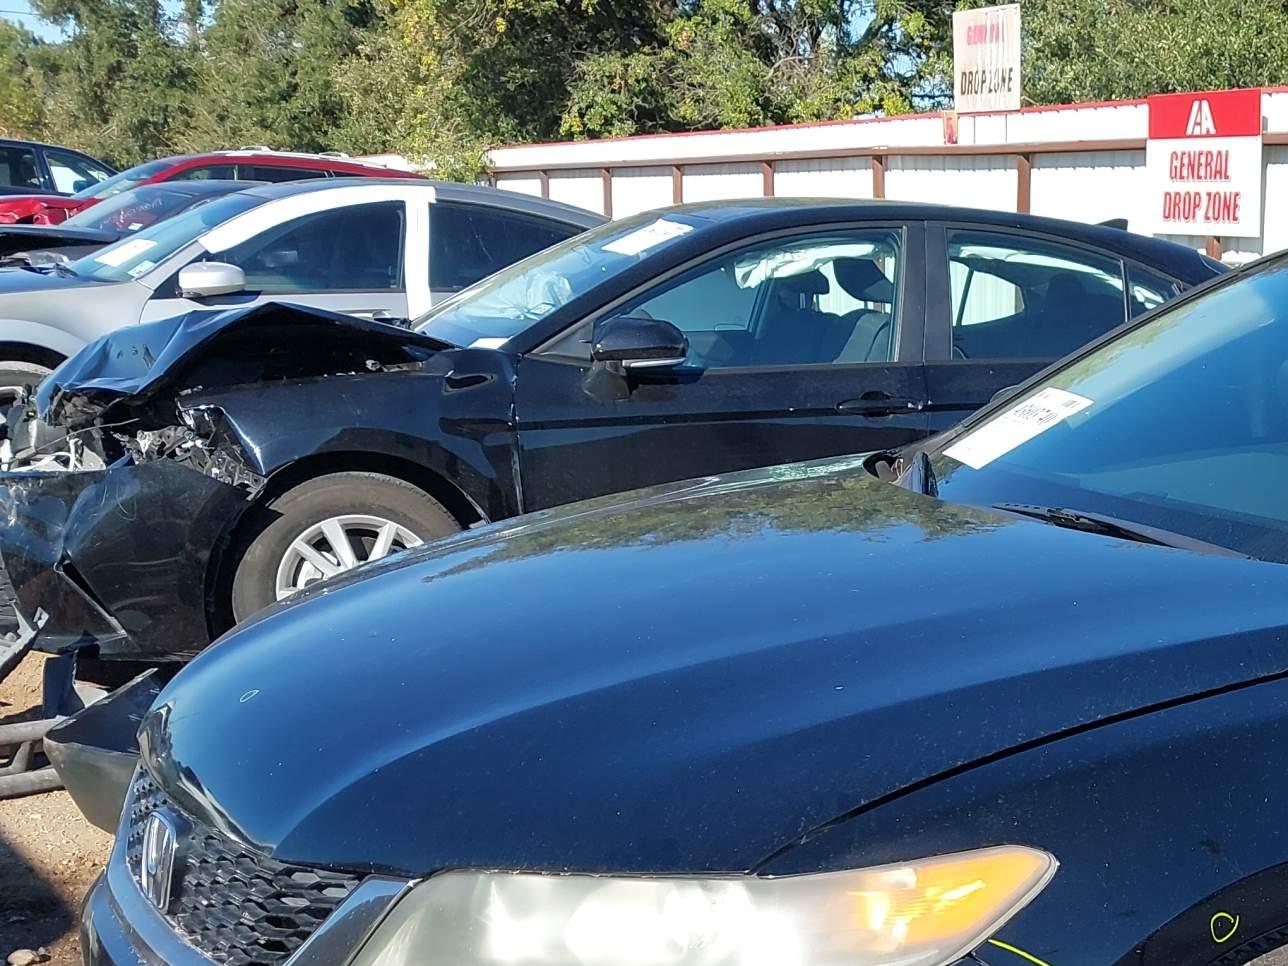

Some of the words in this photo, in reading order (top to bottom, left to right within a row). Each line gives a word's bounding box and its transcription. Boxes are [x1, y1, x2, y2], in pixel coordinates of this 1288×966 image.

[961, 69, 987, 96] DROP
[988, 67, 1013, 94] ZONE
[1169, 150, 1231, 182] GENERAL
[1163, 191, 1202, 223] DROP
[1203, 191, 1241, 224] ZONE
